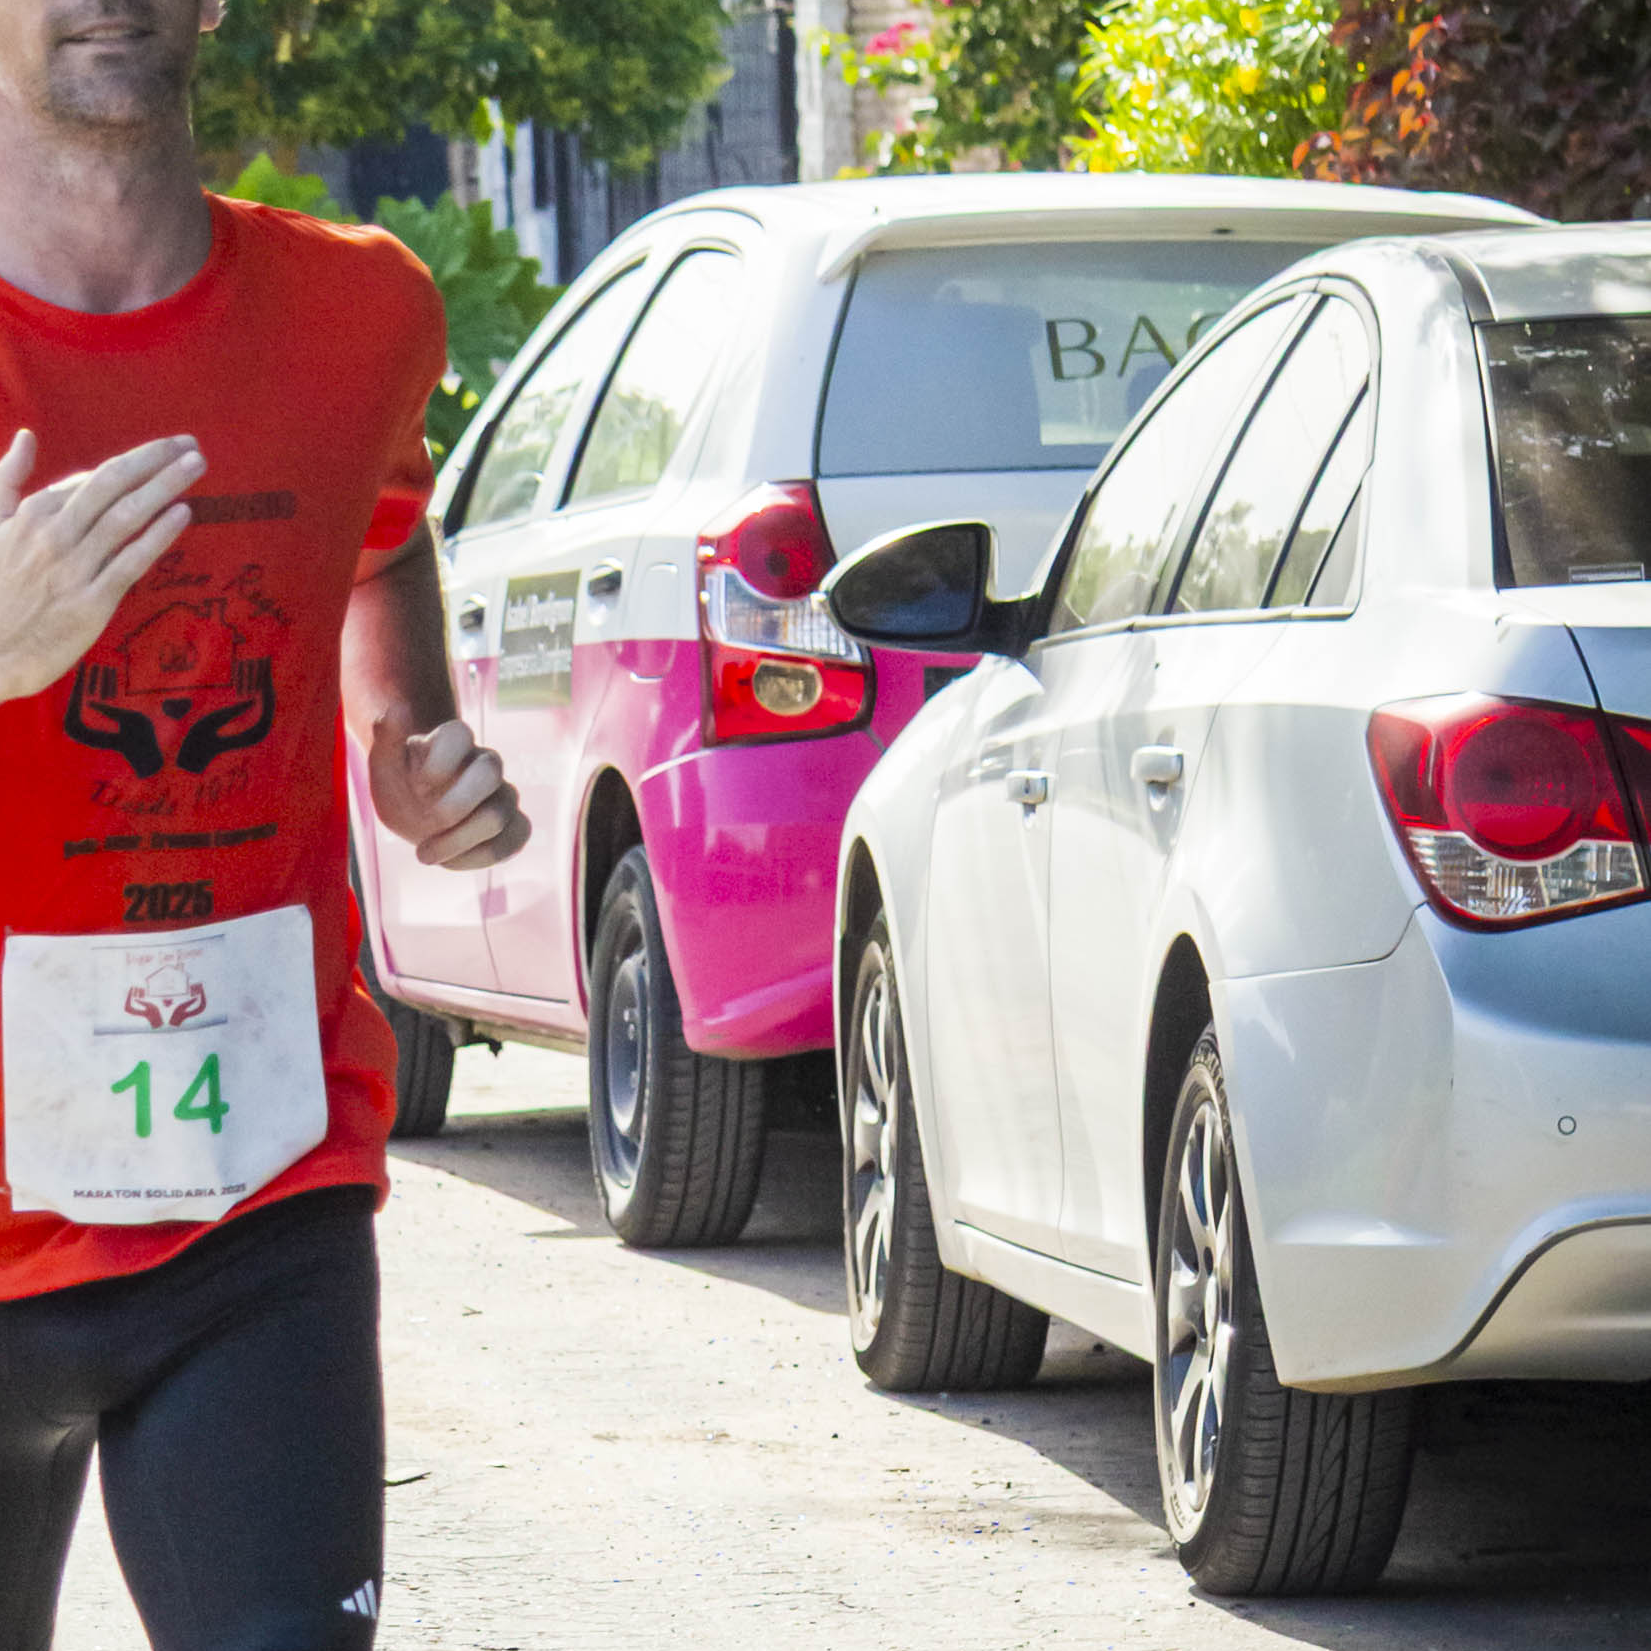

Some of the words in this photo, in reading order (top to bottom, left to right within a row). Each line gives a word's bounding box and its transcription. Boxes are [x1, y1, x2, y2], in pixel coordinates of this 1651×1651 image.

[123, 879, 214, 922] 2025
[110, 1053, 230, 1138] 14
[73, 1189, 142, 1199] MARATON
[145, 1187, 217, 1199] SOLIDARIA
